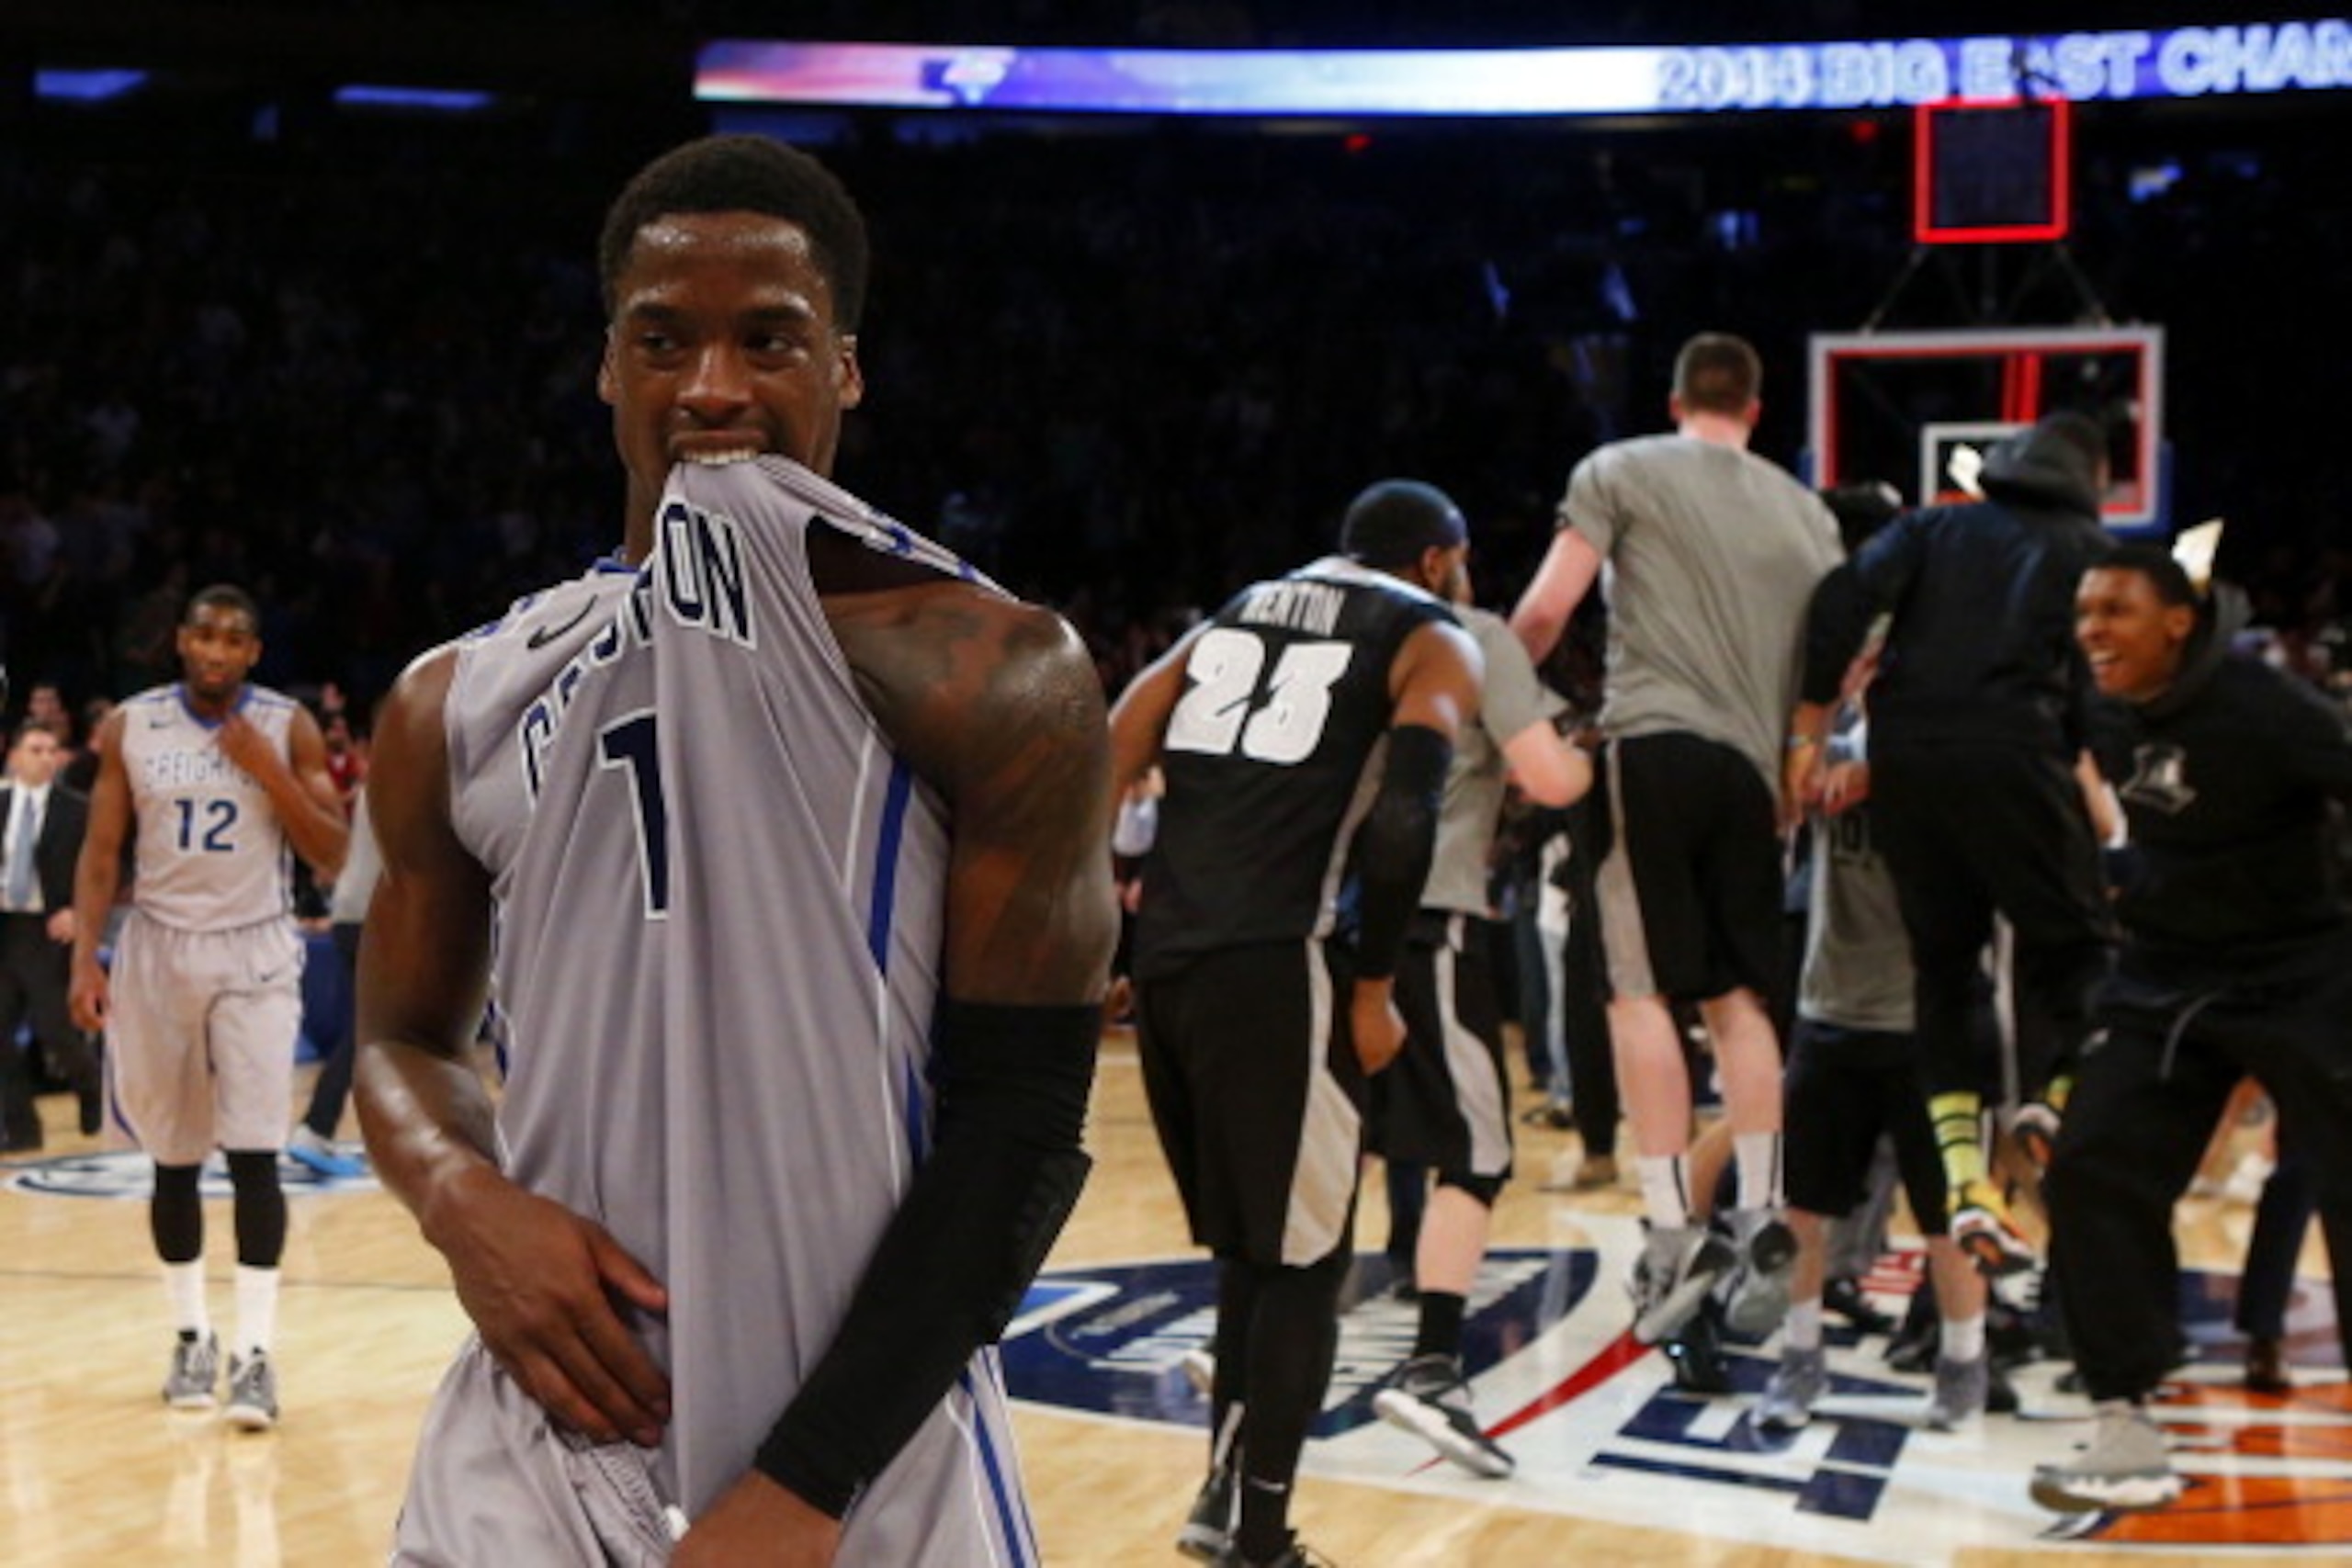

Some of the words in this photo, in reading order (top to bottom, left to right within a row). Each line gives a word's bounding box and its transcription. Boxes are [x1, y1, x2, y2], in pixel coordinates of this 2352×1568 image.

[1822, 39, 1948, 105] BIG
[1164, 627, 1353, 764] 23
[173, 796, 239, 852] 12
[596, 707, 669, 919] 1
